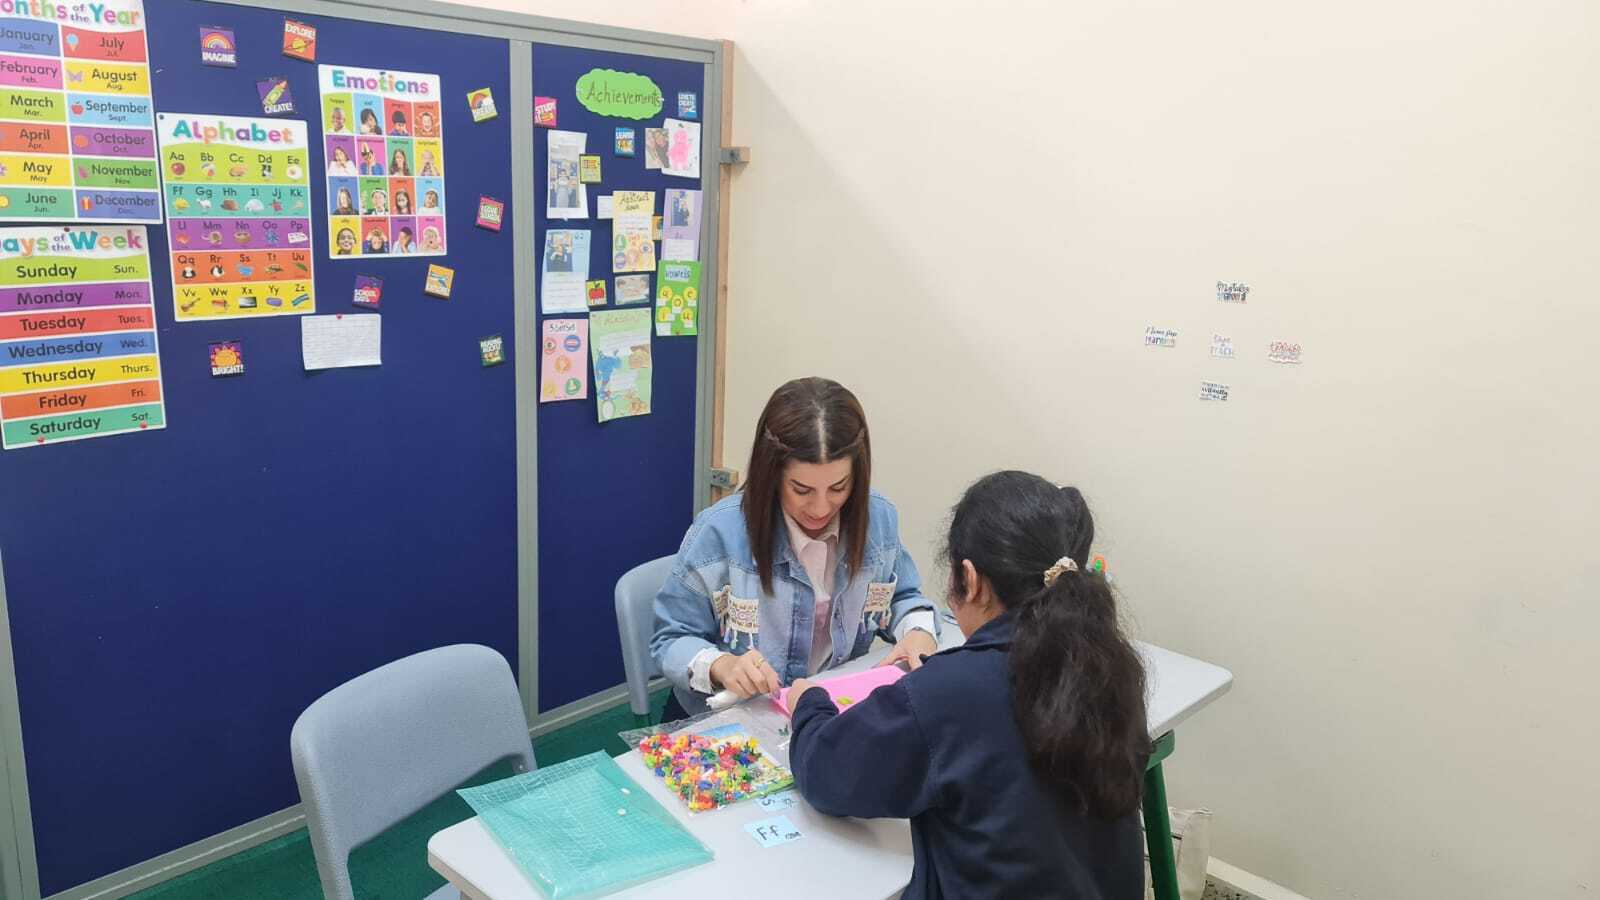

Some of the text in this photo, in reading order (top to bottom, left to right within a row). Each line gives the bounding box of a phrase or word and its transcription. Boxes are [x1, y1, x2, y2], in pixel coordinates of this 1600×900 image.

[0, 0, 67, 19] onths
[72, 4, 86, 12] of
[88, 4, 140, 25] Year
[70, 13, 89, 22] the
[0, 27, 54, 45] January
[99, 37, 125, 50] July
[202, 52, 236, 63] IMAGINE
[0, 61, 58, 78] February
[91, 69, 137, 82] August
[332, 69, 429, 94] Emotions
[10, 95, 54, 108] March
[86, 100, 149, 114] September
[20, 129, 50, 142] April
[172, 119, 294, 144] Alphabet
[93, 132, 146, 145] October
[169, 152, 300, 165] Aa Bb Cc Dd Ee
[23, 162, 53, 175] May
[92, 164, 152, 177] November
[25, 193, 57, 204] June
[172, 186, 183, 196] Ff
[195, 187, 213, 198] Gg
[223, 187, 237, 196] Hh
[272, 189, 282, 199] Jj
[290, 188, 303, 197] Kk
[95, 194, 156, 207] December
[203, 221, 222, 230] Mm
[236, 221, 250, 230] Nn
[262, 220, 278, 230] Oo
[290, 221, 303, 231] Pp
[53, 234, 66, 242] of
[69, 229, 143, 250] Week
[0, 237, 49, 257] ays
[51, 243, 71, 252] the
[177, 253, 304, 266] Qq Rr Ss Tt Uu
[16, 264, 139, 279] Sunday Sun.
[182, 284, 305, 297] Vv Ww Xx Yy Zz
[17, 290, 143, 306] Monday Mon.
[20, 315, 145, 331] Tuesday Tues.
[8, 339, 149, 358] Wednesday Wed.
[23, 364, 153, 384] Thursday Thurs.
[212, 364, 244, 376] BRIGHT!
[39, 388, 147, 409] Friday Fri.
[30, 417, 102, 436] Saturday
